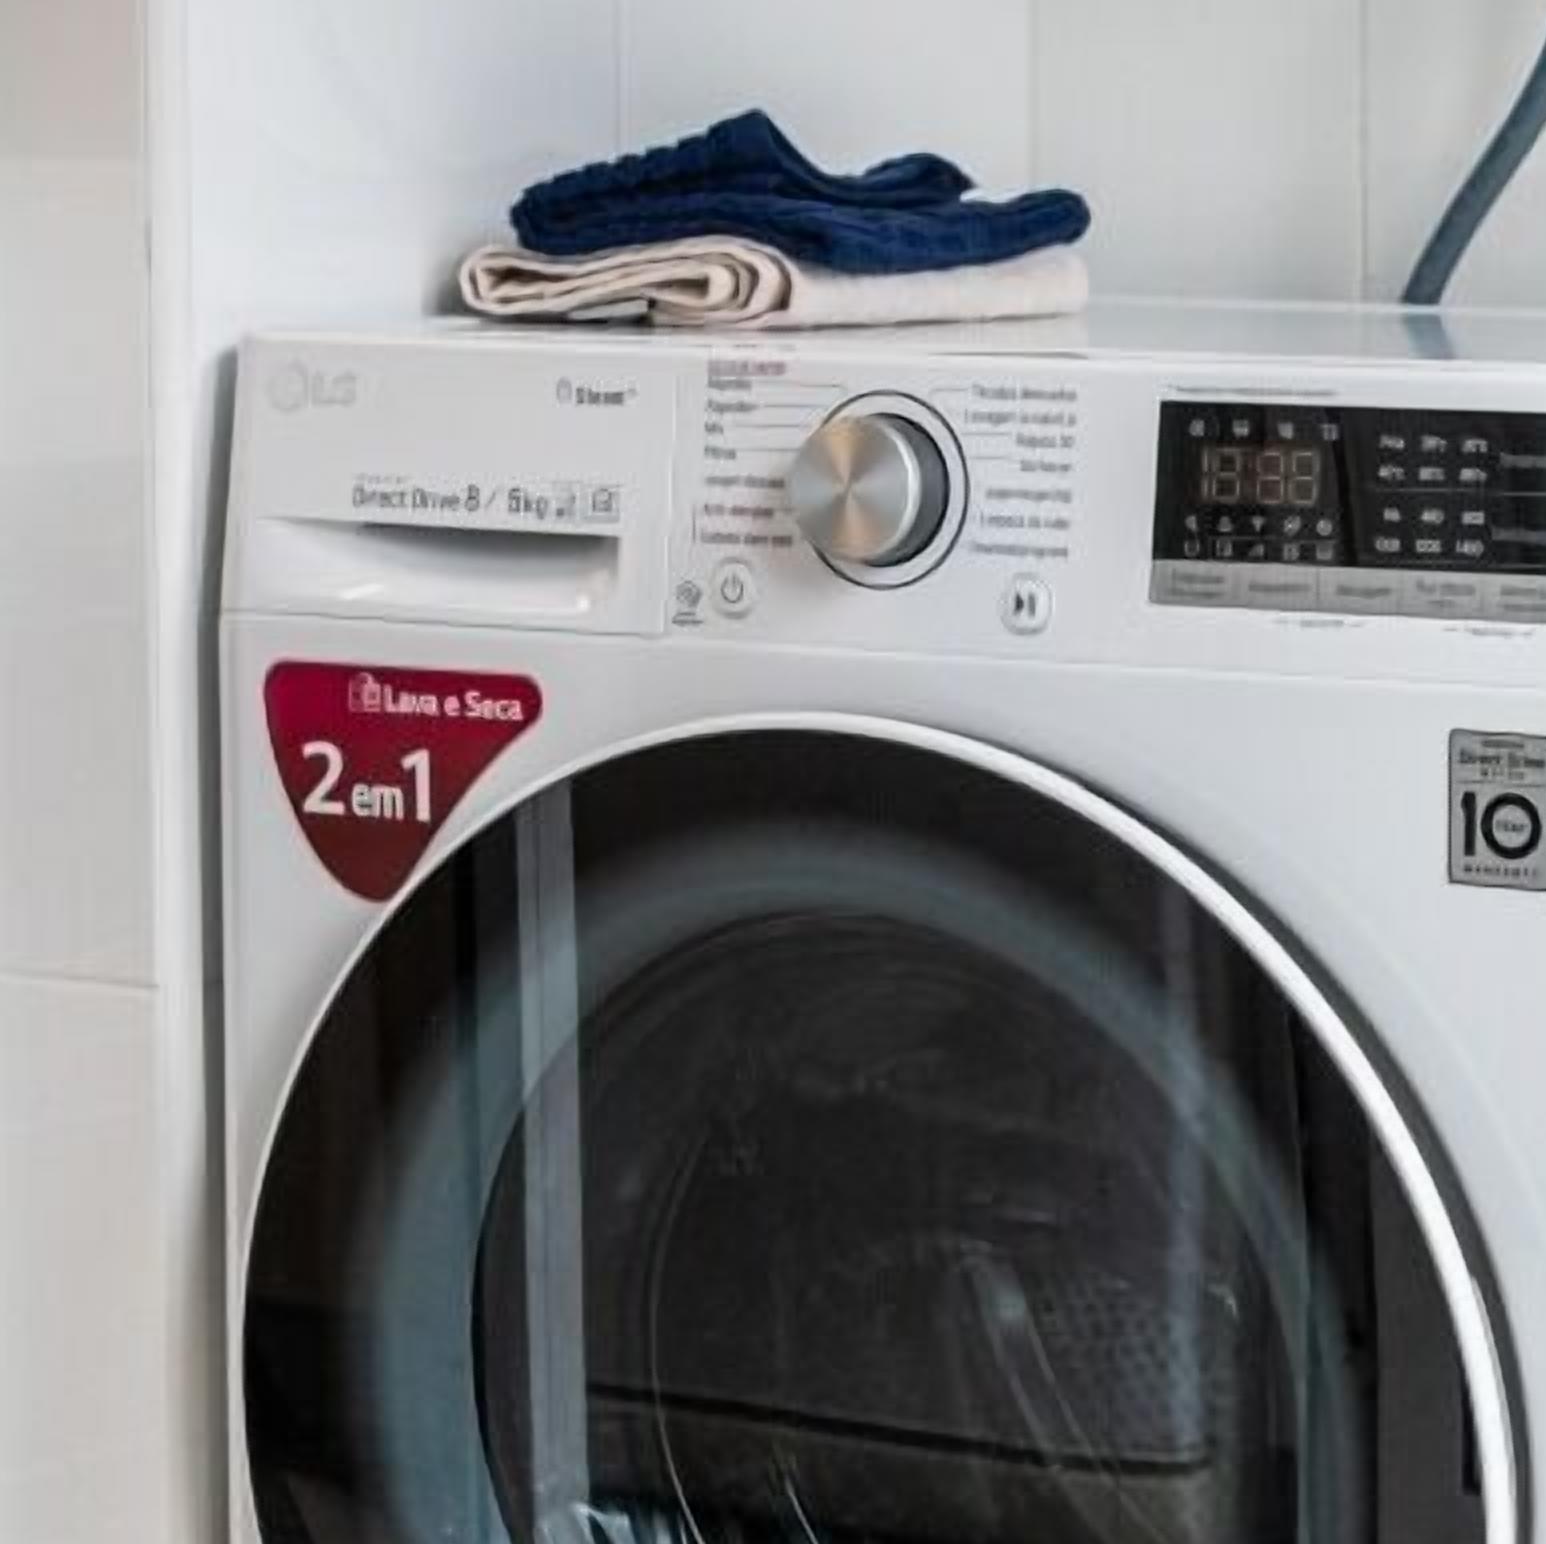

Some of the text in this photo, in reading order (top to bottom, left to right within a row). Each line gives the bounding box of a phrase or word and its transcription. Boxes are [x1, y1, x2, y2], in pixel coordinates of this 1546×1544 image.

[384, 684, 523, 721] Lava e Seca
[302, 740, 431, 824] 2 em 1
[1460, 790, 1543, 860] 10
